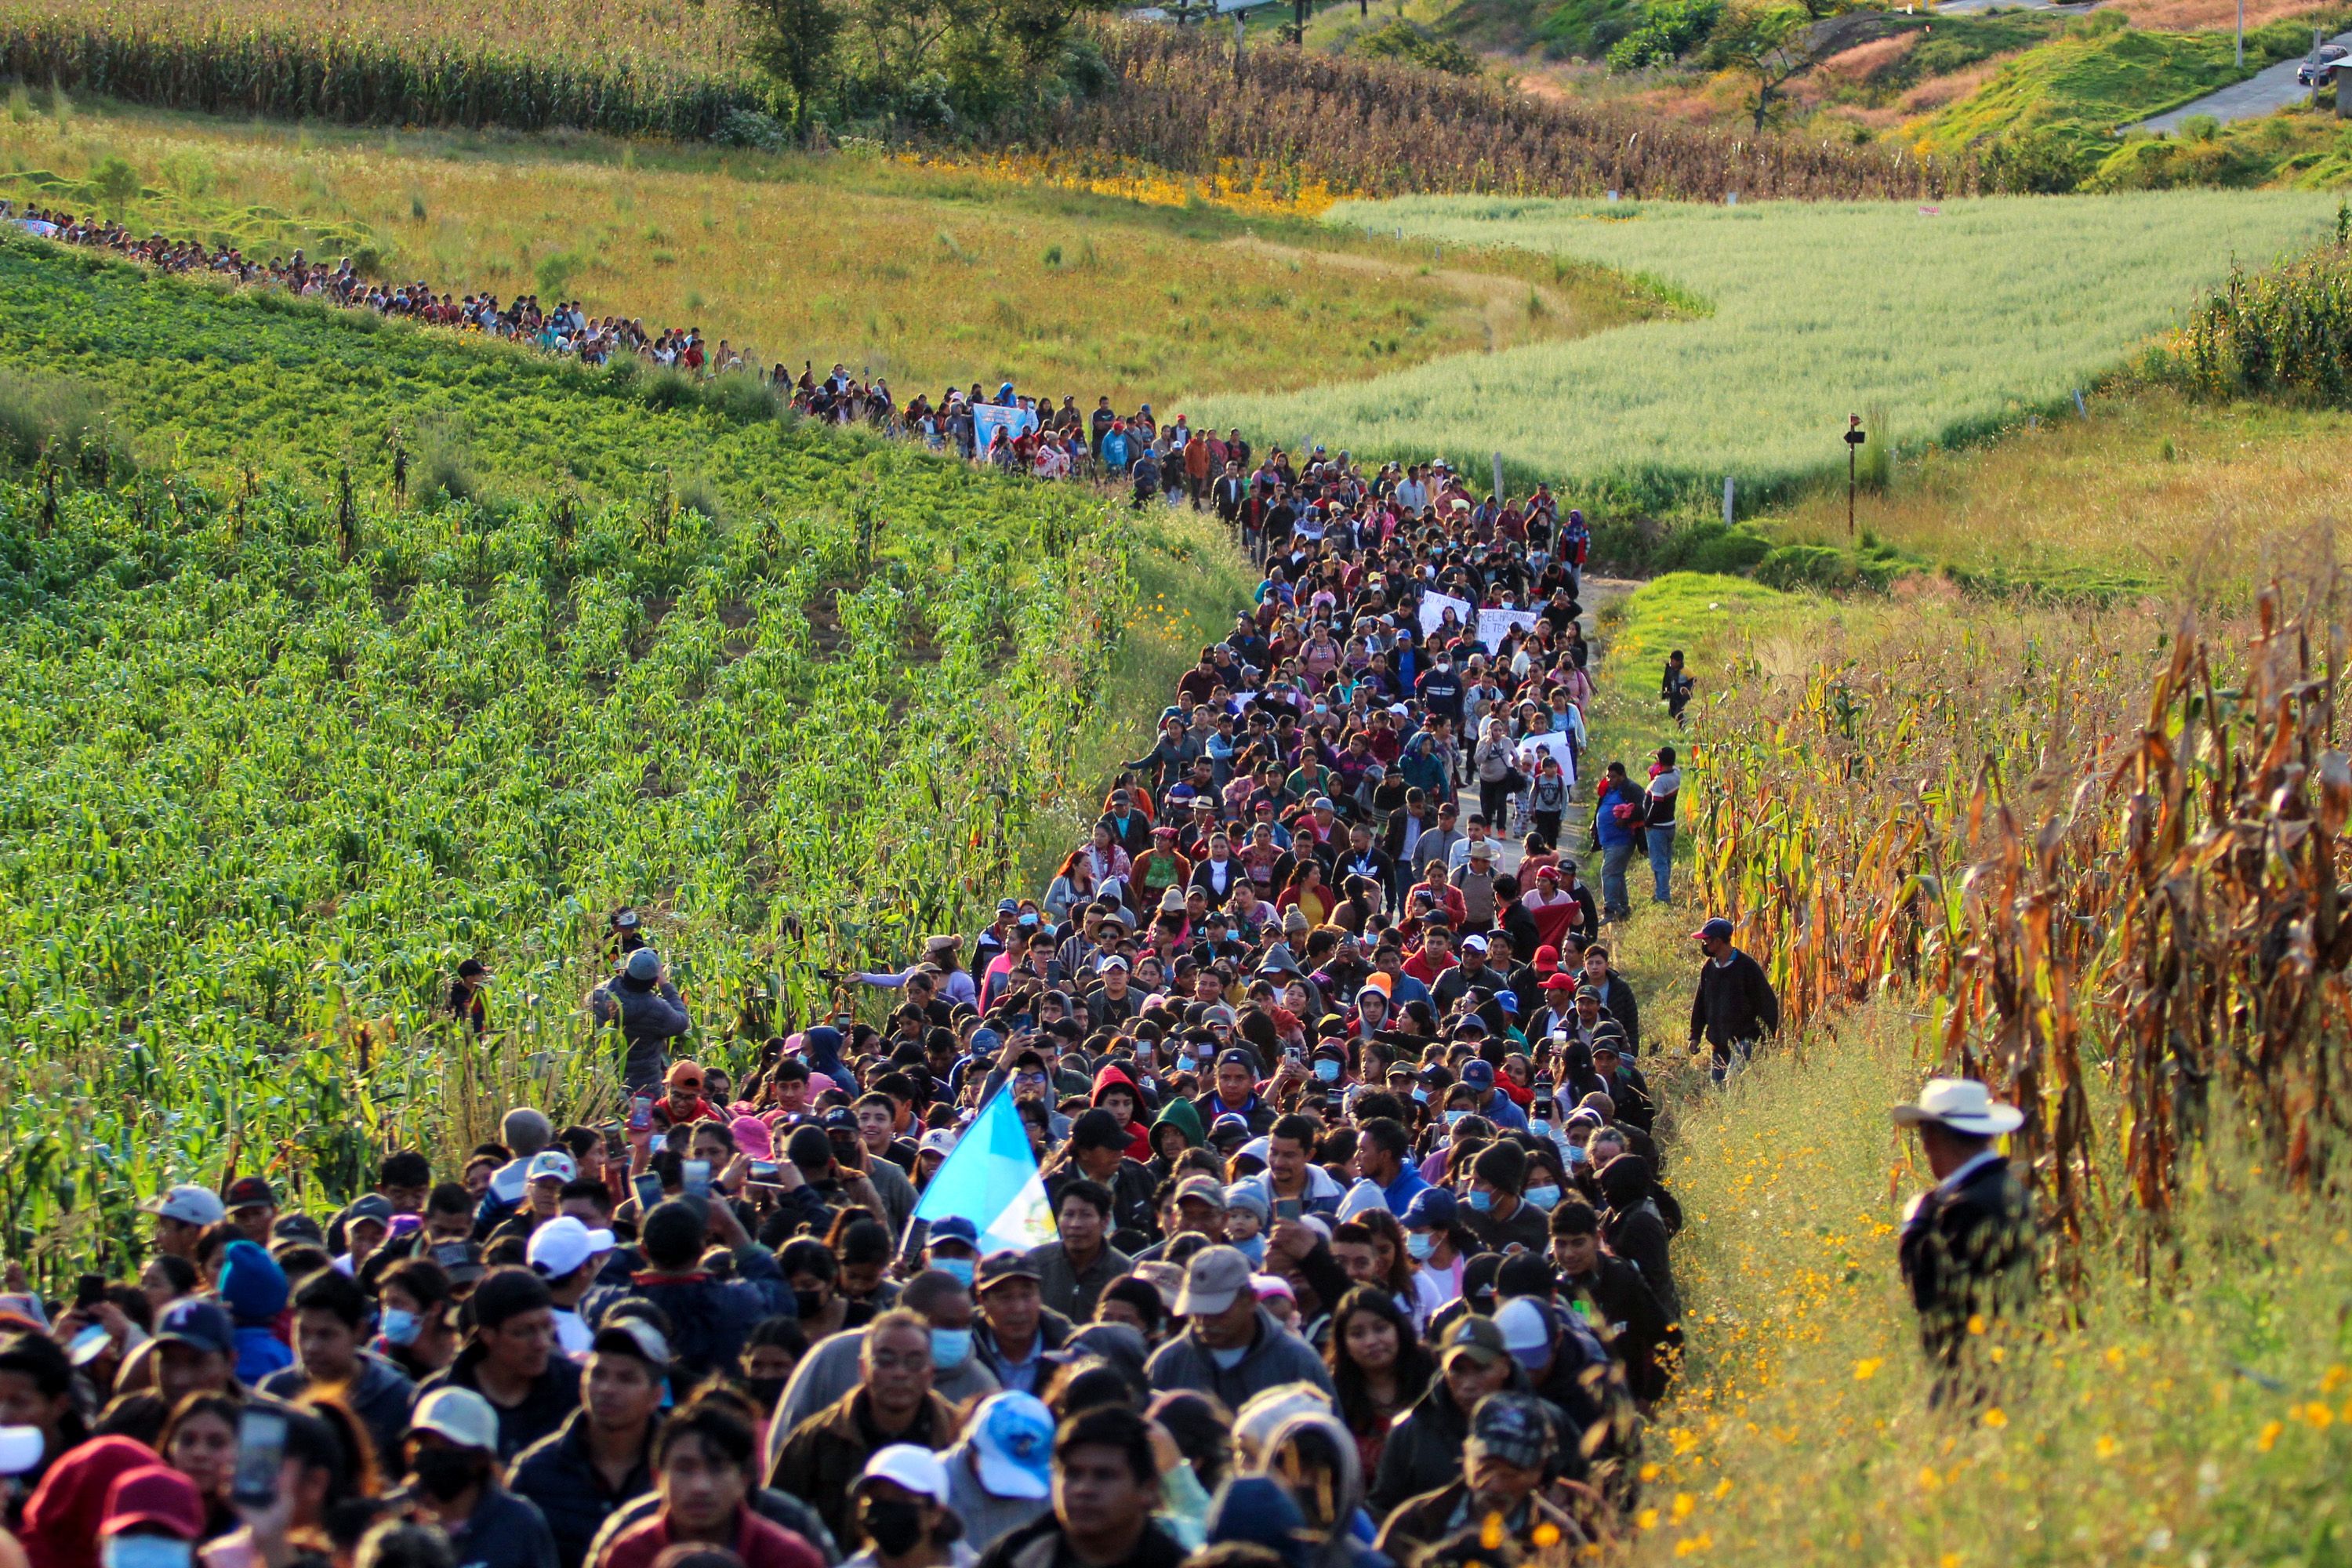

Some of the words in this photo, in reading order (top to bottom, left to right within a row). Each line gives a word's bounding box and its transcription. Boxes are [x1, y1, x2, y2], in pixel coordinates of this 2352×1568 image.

[1425, 594, 1434, 603] NO
[1481, 611, 1534, 622] RECHAZAMOS
[1481, 624, 1489, 633] EL
